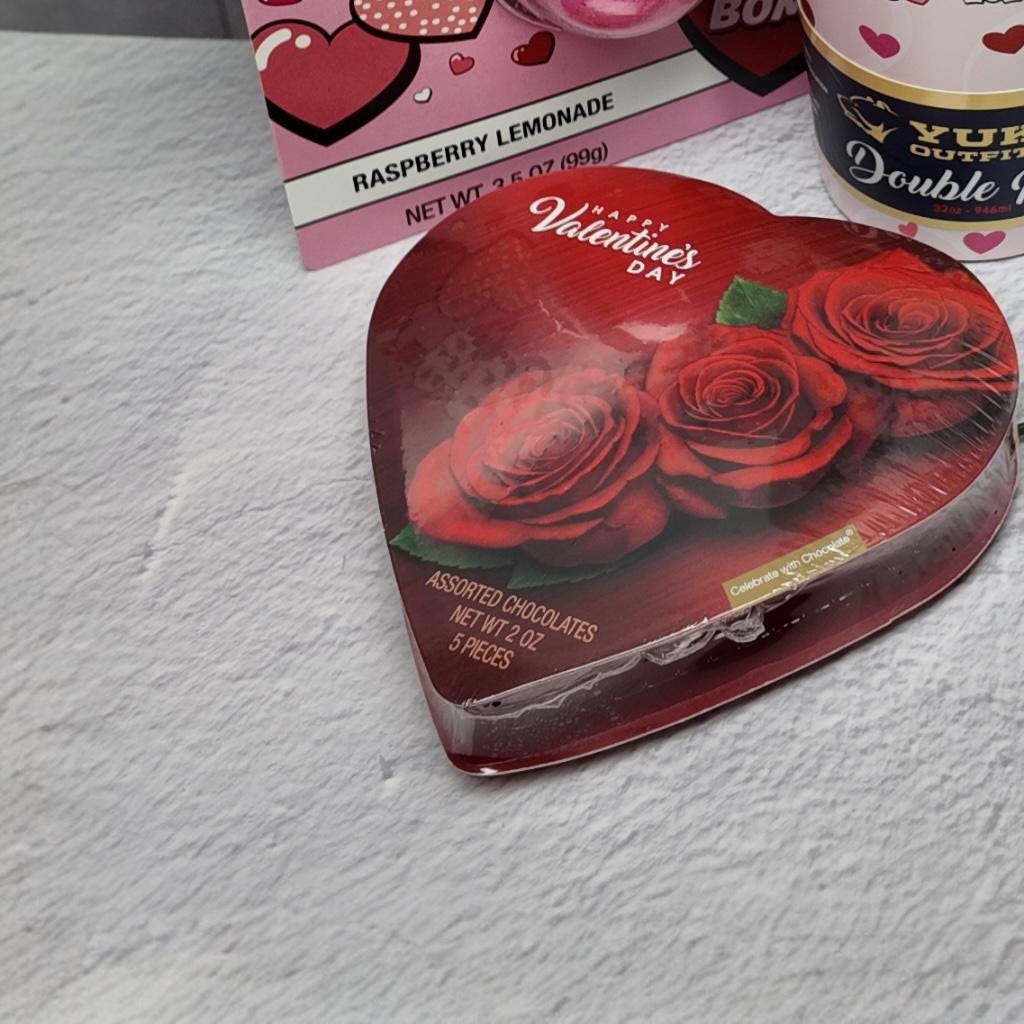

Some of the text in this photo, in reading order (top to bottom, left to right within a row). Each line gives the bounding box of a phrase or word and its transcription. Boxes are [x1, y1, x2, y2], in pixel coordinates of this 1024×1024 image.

[352, 92, 615, 193] RASPBERRY LEMONADE
[405, 196, 446, 226] NET
[451, 184, 484, 210] WT
[560, 142, 609, 170] (99g)
[846, 139, 1000, 202] Double
[529, 196, 702, 269] Valentine's
[591, 205, 669, 232] HAPPY
[626, 260, 685, 286] DAY
[730, 569, 779, 596] Celebrate
[780, 559, 801, 574] with
[425, 569, 598, 643] ASSORTED CHOCOLATES
[449, 604, 545, 652] NET WT 2 OZ
[448, 632, 515, 670] 5 PIECES
